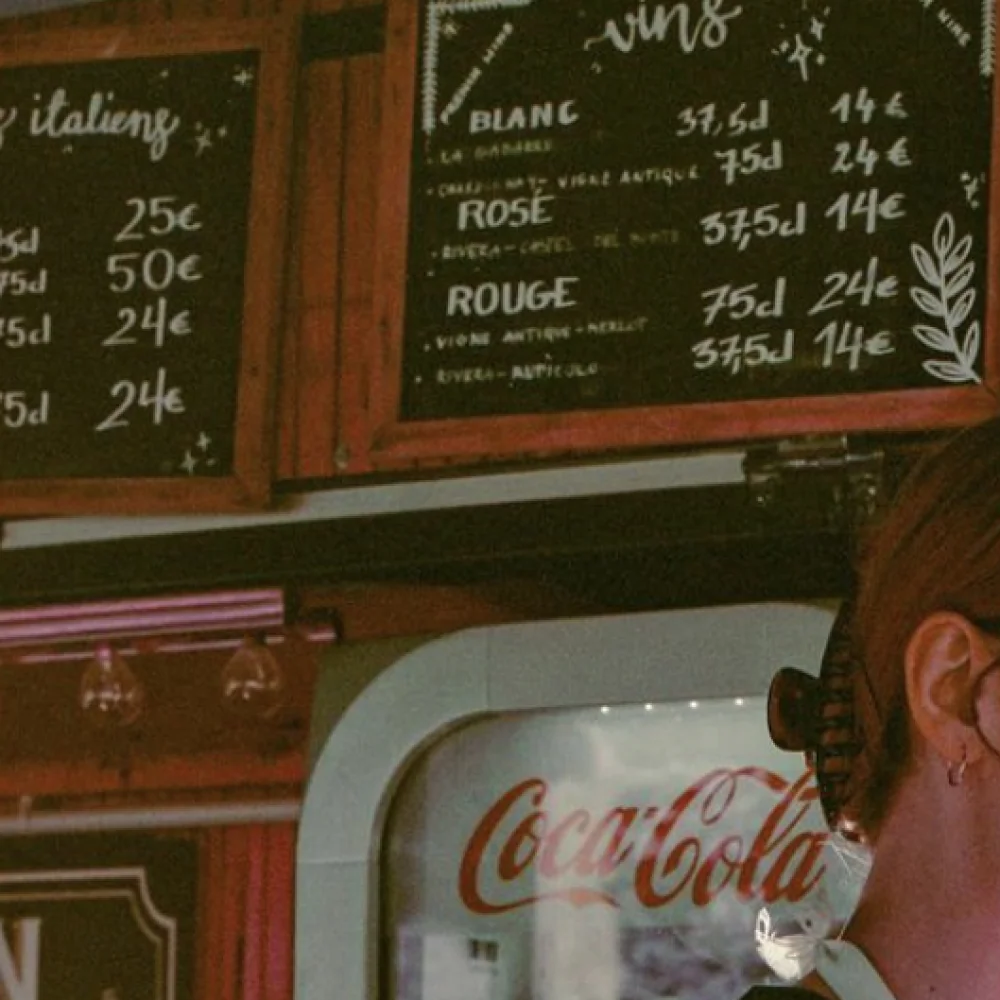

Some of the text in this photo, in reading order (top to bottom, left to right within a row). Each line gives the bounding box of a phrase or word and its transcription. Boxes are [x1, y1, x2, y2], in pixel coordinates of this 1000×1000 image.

[584, 0, 742, 52] vins
[469, 100, 580, 133] BLANC
[713, 140, 784, 185] 75d
[114, 197, 202, 242] 25€
[457, 189, 555, 231] ROSÉ
[824, 188, 906, 235] 14€
[106, 248, 202, 292] 50€
[446, 256, 899, 326] ROUGE 75d 24€
[101, 298, 192, 347] 24€
[813, 320, 896, 371] 14€
[95, 367, 186, 431] 24€
